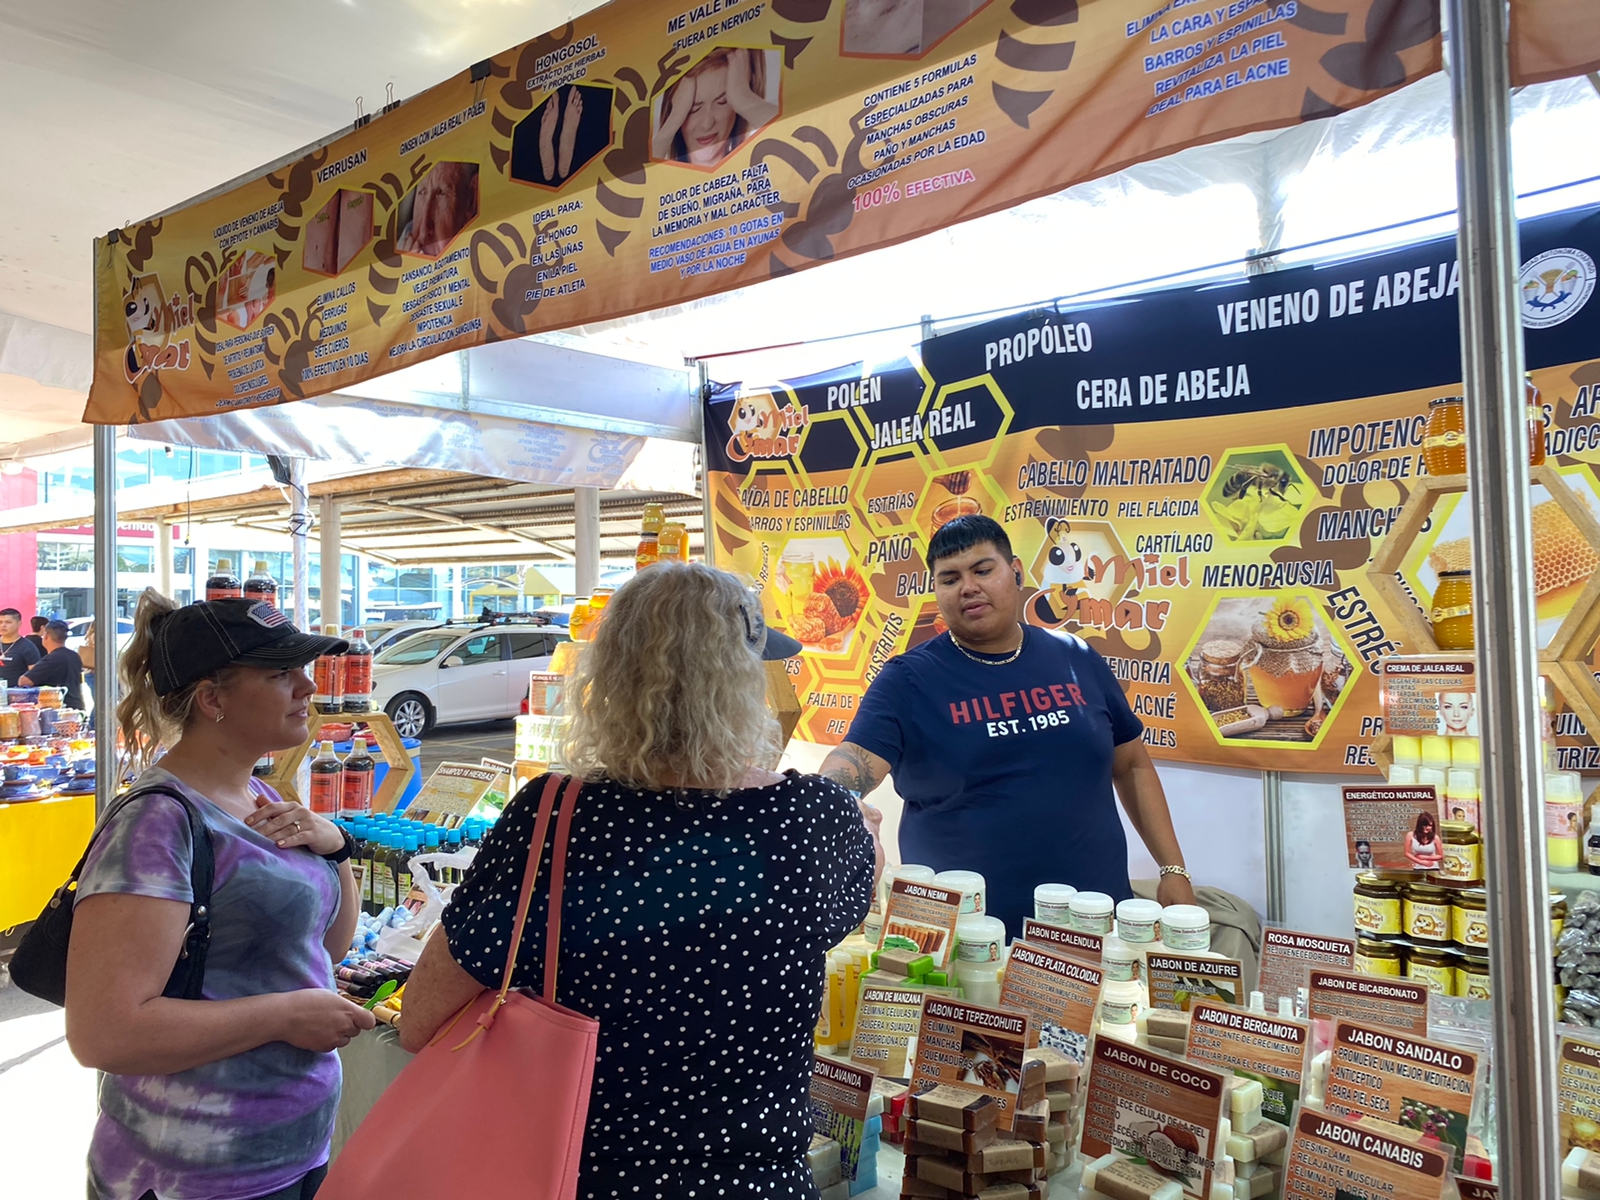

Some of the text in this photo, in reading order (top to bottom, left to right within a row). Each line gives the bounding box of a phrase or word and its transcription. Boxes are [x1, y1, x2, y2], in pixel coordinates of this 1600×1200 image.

[668, 0, 721, 33] ME VALE
[707, 24, 718, 38] DE
[721, 3, 765, 31] NERVIOS"
[536, 35, 598, 71] HONGOSOL
[1144, 3, 1296, 71] BARROS Y ESPINILLAS
[527, 49, 606, 88] EXTRACTO DE HIERBAS
[549, 68, 586, 89] PROPOLEO
[864, 54, 976, 106] CONTIENE 5 FORMULAS
[1156, 34, 1285, 95] REVITALIZA LA PIEL
[865, 76, 973, 126] ESPECIALIZADAS PARA
[1146, 61, 1288, 117] IDEAL PARA EL ACNE
[867, 96, 968, 144] MANCHAS OBSCURAS
[874, 119, 956, 160] PAÑO Y MANCHAS
[317, 149, 367, 183] VERRUSAN
[658, 178, 771, 221] DE SUEÑO, MIGRAÑA, PARA
[660, 164, 769, 206] DOLOR DE CABEZA, FALTA
[853, 170, 974, 210] 100% EFECTIVA
[533, 201, 583, 223] IDEAL PARA:
[652, 191, 780, 237] LA MEMORIA Y MAL CARACTER
[538, 225, 578, 245] EL HONGO
[649, 212, 783, 258] RECOMENDACIONES: 10 GOTAS EN
[532, 242, 583, 265] EN LAS UÑAS
[317, 282, 356, 305] ELIMINA CALLOS
[526, 279, 585, 300] PIE DE ATLETA
[1330, 280, 1364, 318] DE
[1373, 260, 1459, 310] ABEJA
[322, 303, 347, 320] VERRUGAS
[1217, 288, 1319, 335] VENENO
[315, 338, 349, 358] SIETE CUEROS
[985, 320, 1092, 371] PROPÓLEO
[828, 376, 882, 410] POLEN
[1077, 364, 1250, 410] CERA DE ABEJA
[871, 402, 975, 450] JALEA REAL
[1308, 416, 1423, 458] IMPOTENC
[1018, 455, 1211, 490] CABELLO MALTRATADO
[1323, 457, 1410, 486] DOLOR DE
[737, 486, 848, 508] AÍDA DE CABELLO
[868, 490, 914, 514] ESTRÍAS
[1005, 496, 1198, 523] ESTREÑIMIENTO PIEL FLÁCIDA
[787, 518, 793, 530] Y
[795, 514, 850, 531] ESPINILLAS
[868, 534, 912, 563] PAÑO
[1136, 531, 1212, 553] CARTÍLAGO
[1088, 554, 1190, 589] Miel
[1202, 561, 1333, 588] MENOPAUSIA
[865, 612, 902, 683] GASTRITIS
[807, 693, 853, 708] FALTA DE
[949, 683, 1087, 724] HILFIGER
[1134, 693, 1176, 719] ACNÉ
[826, 720, 846, 733] PIE
[987, 710, 1070, 737] EST. 1985
[1346, 791, 1394, 799] ENERGÉTICO
[904, 885, 948, 901] JABON NEMM
[1027, 926, 1100, 949] JABON DE CALENDULA
[1268, 934, 1350, 954] ROSA MOSQUETA
[1012, 948, 1100, 984] JABON DE PLATA COLOIDAL
[1150, 957, 1237, 975] JABON DE AZUFRE
[1318, 978, 1417, 999] JABON DE BICARBONATO
[927, 1003, 1022, 1031] JABON DE TEPEZCOHUITE
[928, 1021, 955, 1035] ELIMINA
[1199, 1009, 1298, 1040] JABON DE BERGAMOTA
[924, 1050, 974, 1069] QUEMADURAS
[926, 1036, 960, 1051] MANCHAS
[1349, 1030, 1462, 1070] JABON SANDALO
[921, 1063, 940, 1076] PAÑO
[1104, 1048, 1211, 1090] JABON DE COCO
[1336, 1067, 1382, 1089] ANTICEPTICO
[1300, 1139, 1350, 1163] DESINFLAMA
[1316, 1122, 1423, 1168] JABON CANABIS
[1298, 1153, 1393, 1192] RELAJANTE MUSCULAR
